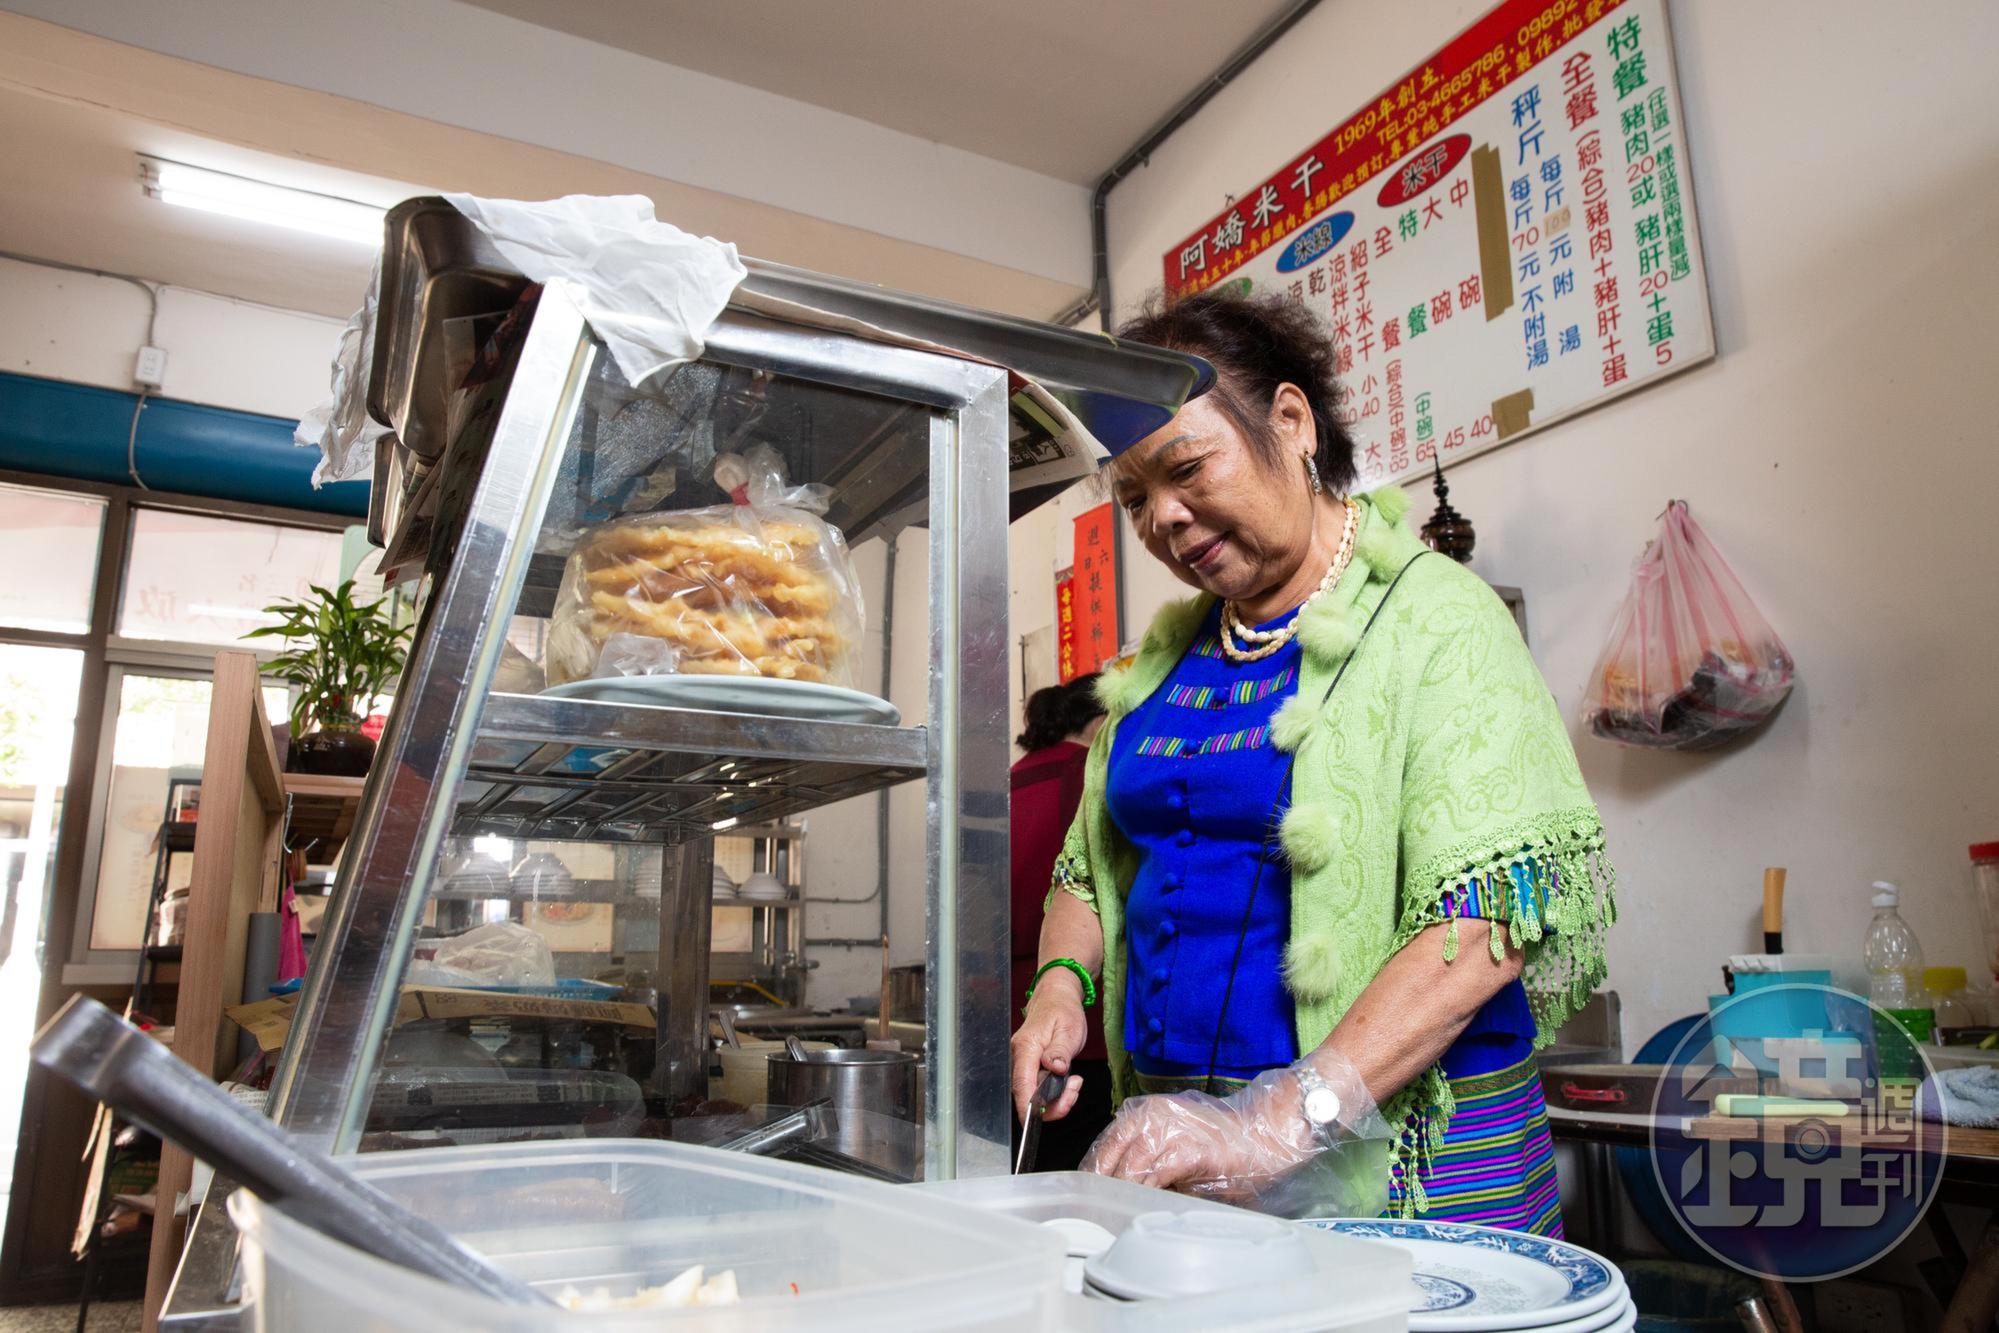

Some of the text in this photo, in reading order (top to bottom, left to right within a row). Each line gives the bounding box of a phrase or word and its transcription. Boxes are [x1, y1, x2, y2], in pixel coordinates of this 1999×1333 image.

[1561, 51, 1599, 132] 全餐
[1606, 14, 1649, 101] 特餐
[1511, 84, 1545, 166] 秤斤
[1401, 144, 1449, 196] 米干
[1178, 155, 1325, 281] 阿嬌米干
[1294, 220, 1334, 268] 米線
